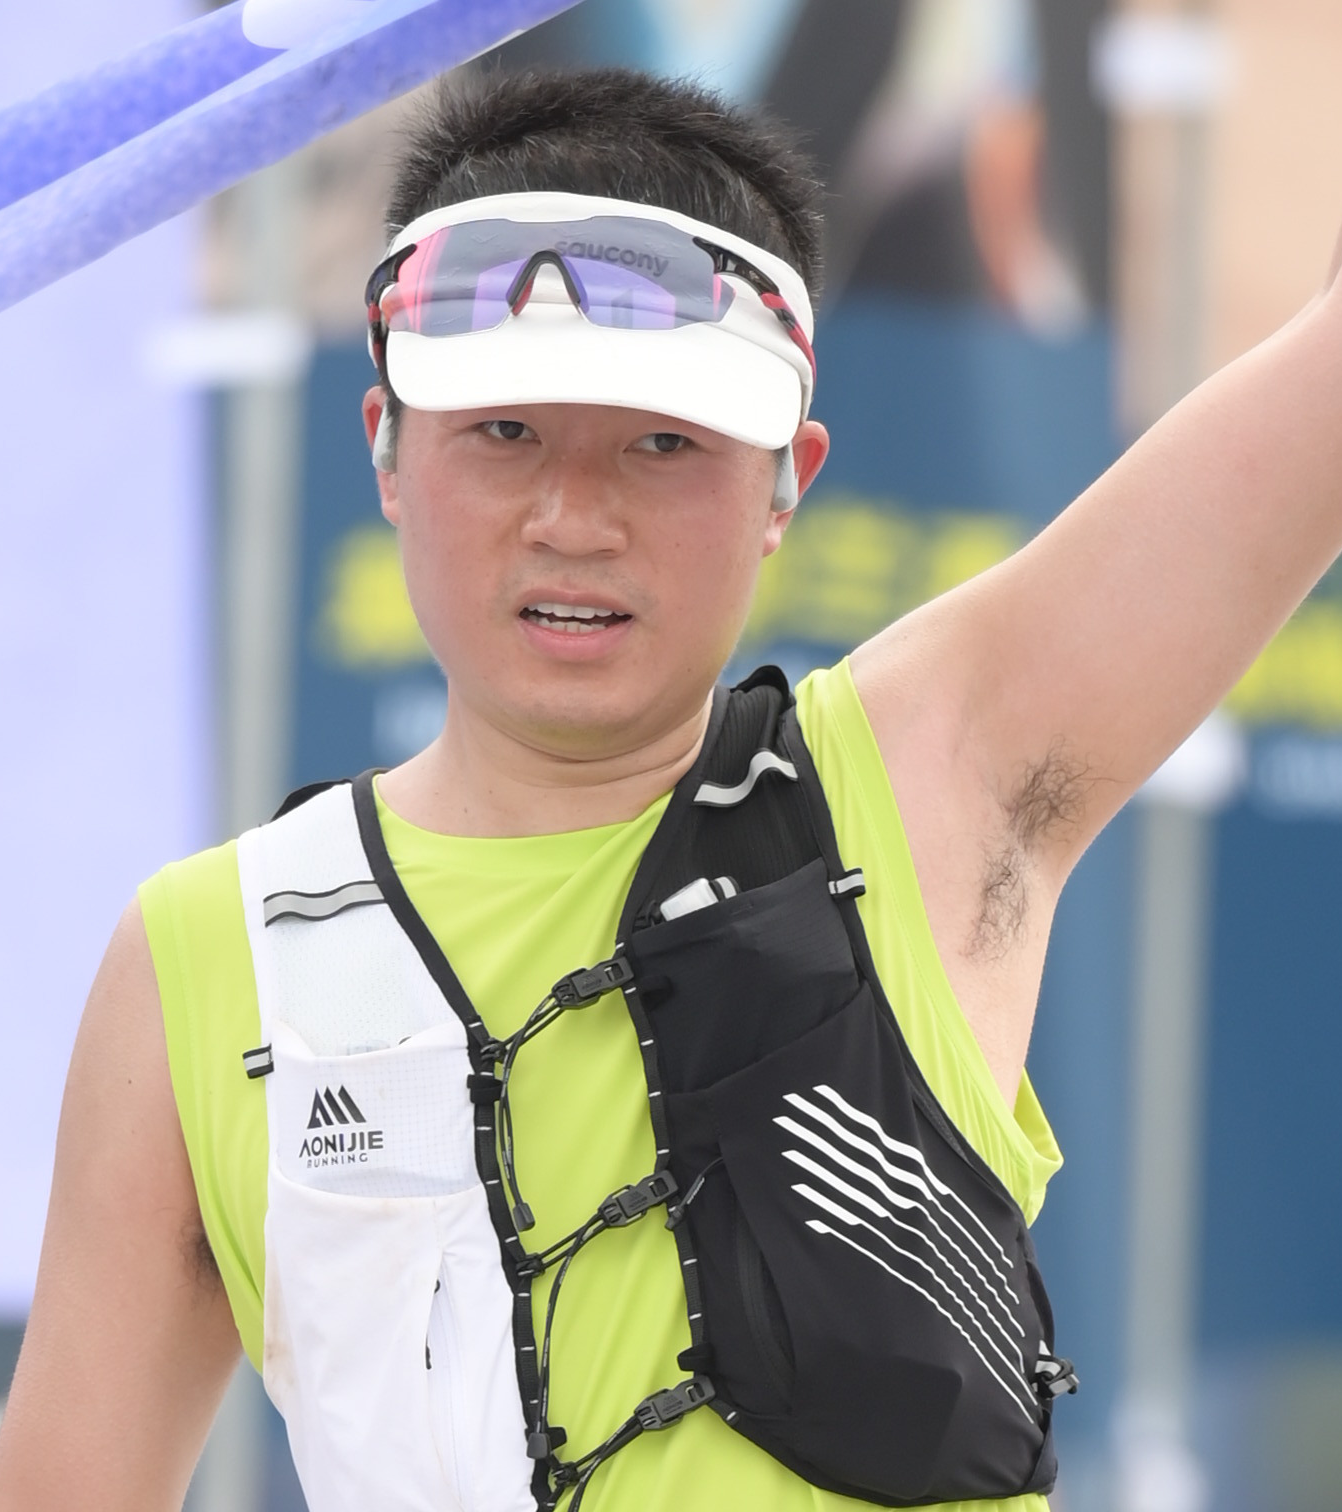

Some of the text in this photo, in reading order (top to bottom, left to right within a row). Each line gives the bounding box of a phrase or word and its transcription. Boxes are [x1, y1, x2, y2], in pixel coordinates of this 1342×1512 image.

[555, 241, 670, 278] saucony
[299, 1131, 384, 1158] AONIJIE
[307, 1153, 368, 1169] RUNNING
